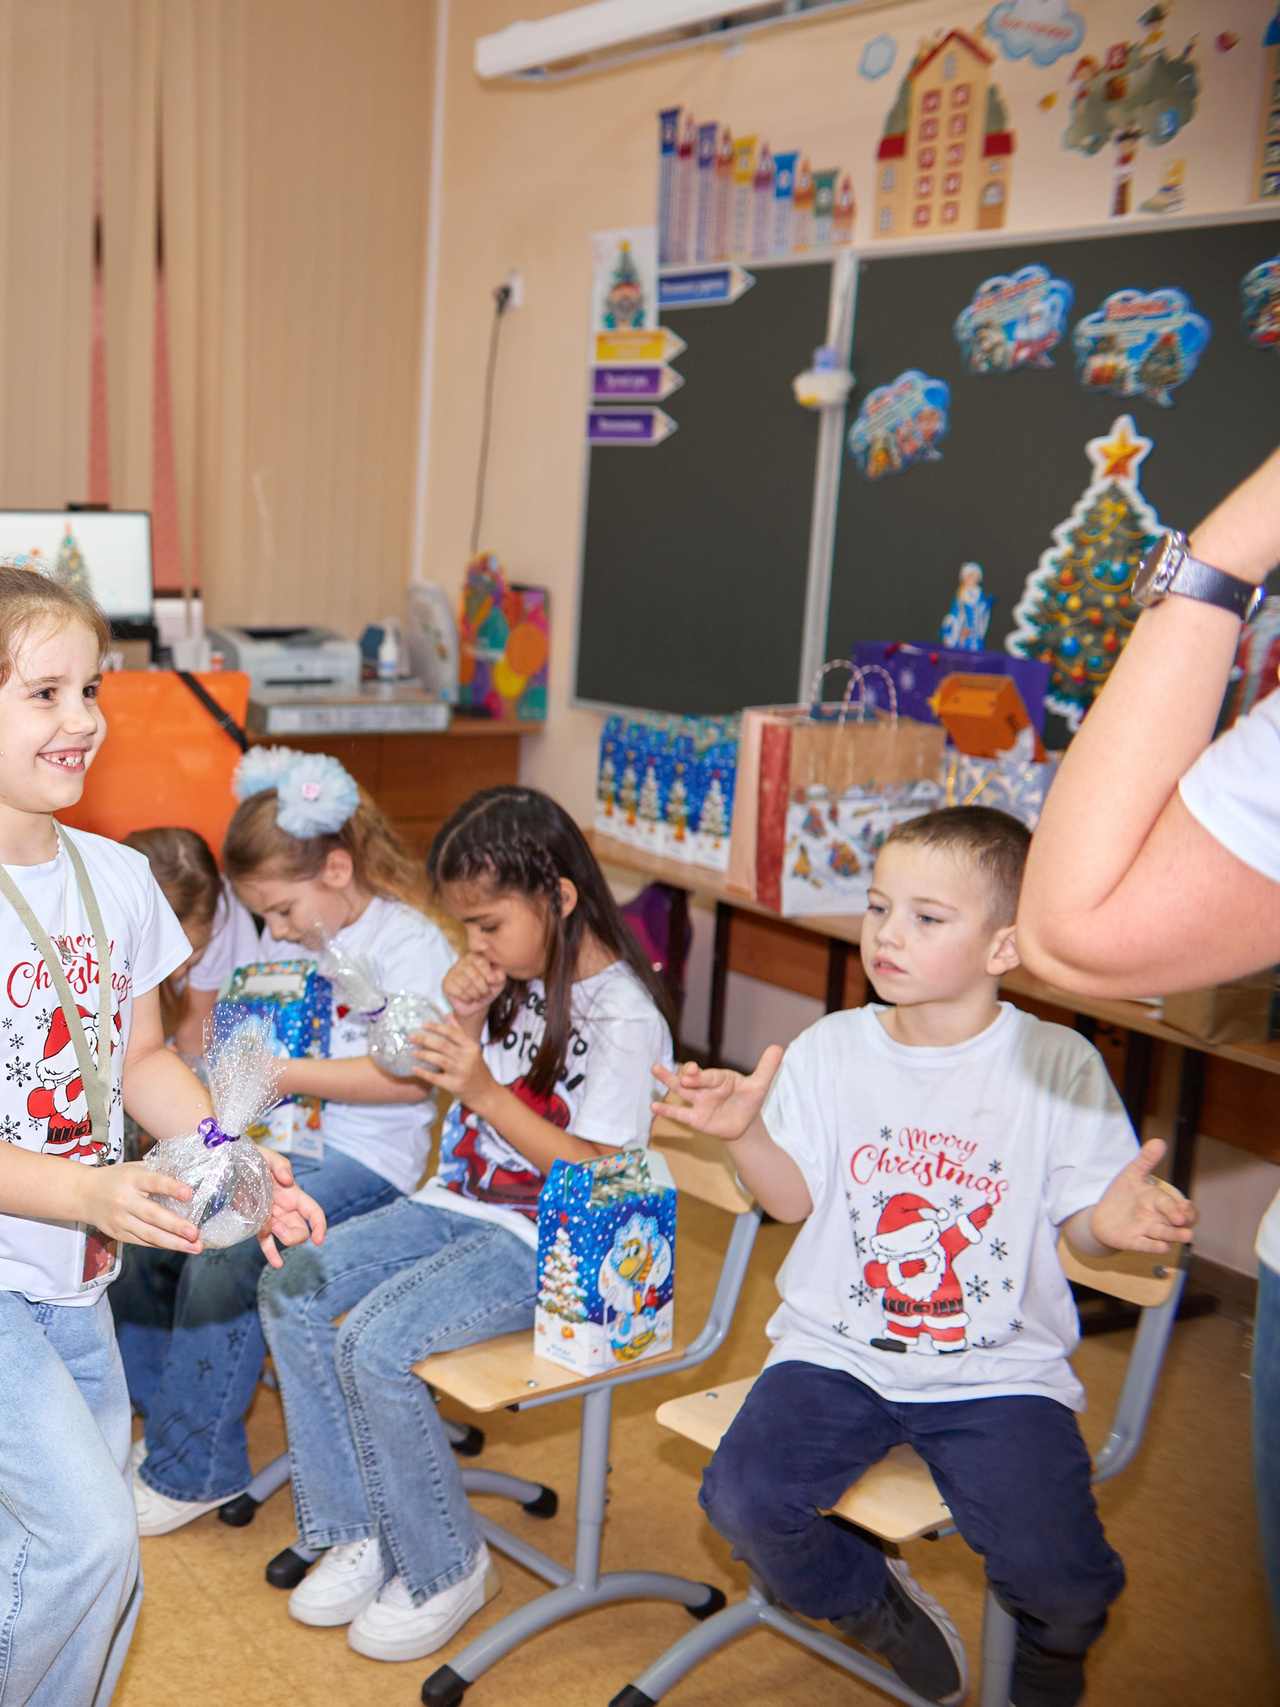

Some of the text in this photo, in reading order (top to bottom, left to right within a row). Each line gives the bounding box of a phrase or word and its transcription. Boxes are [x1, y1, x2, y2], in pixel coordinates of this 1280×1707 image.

[7, 952, 133, 1009] Chistas
[899, 1127, 978, 1162] Merry
[850, 1145, 1009, 1206] Christmas
